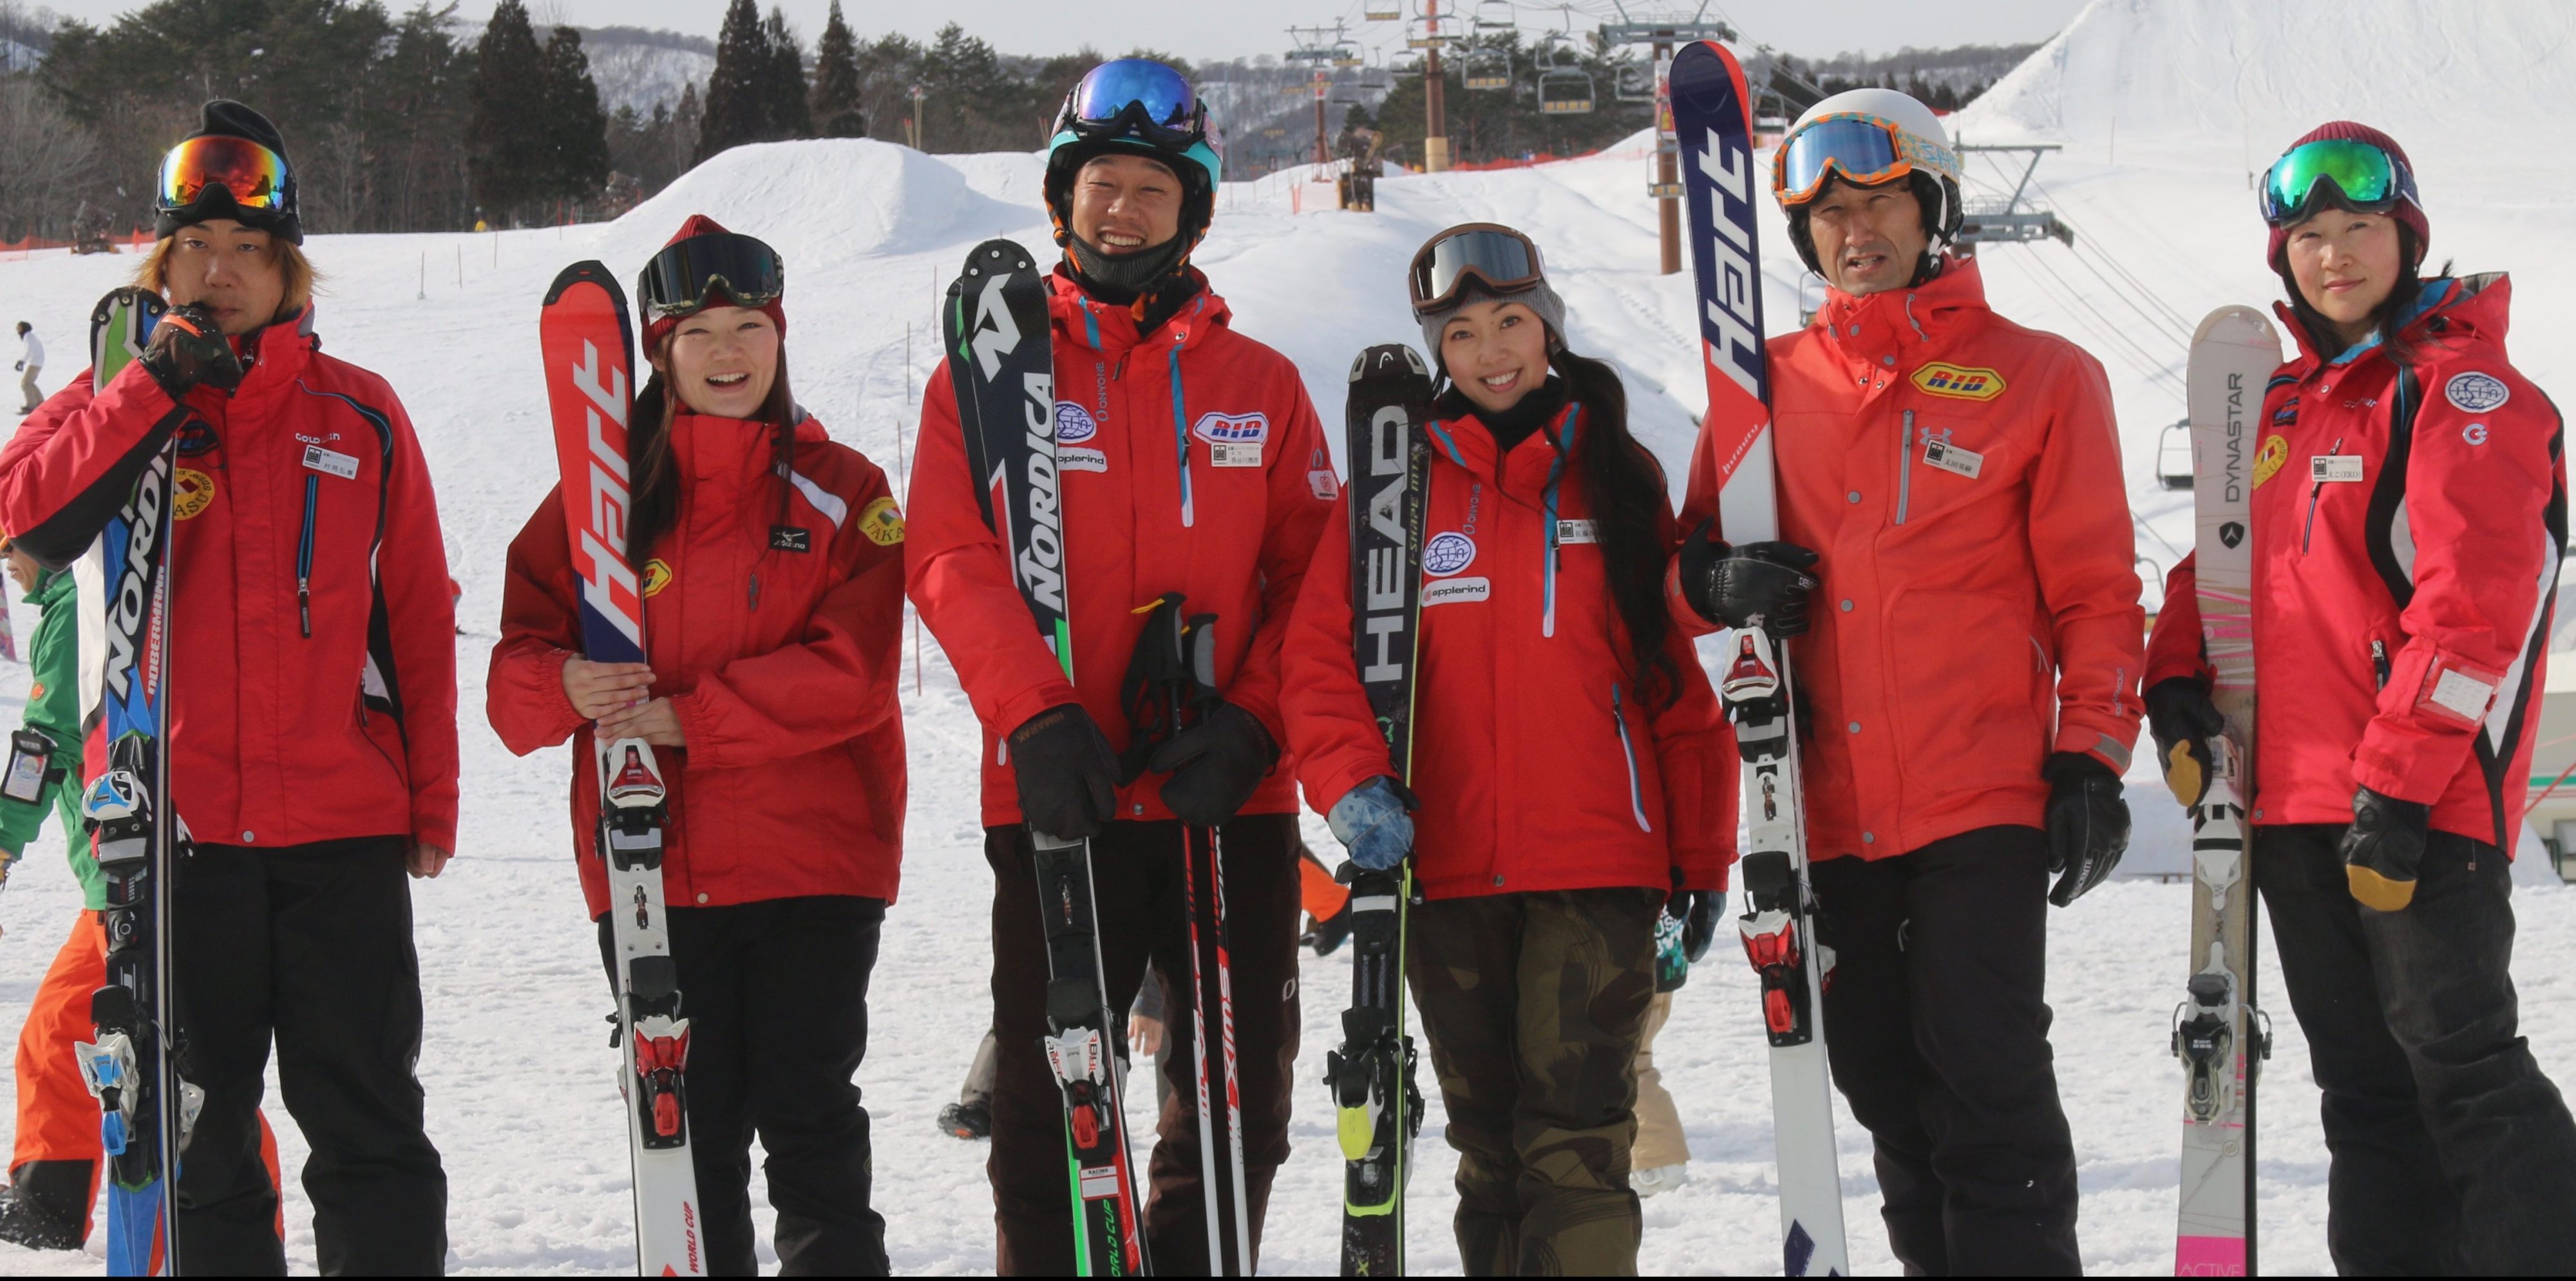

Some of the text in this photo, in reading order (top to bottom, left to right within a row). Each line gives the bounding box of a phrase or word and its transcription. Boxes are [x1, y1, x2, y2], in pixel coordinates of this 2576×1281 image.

[2225, 373, 2243, 502] DYNASTAR
[1019, 372, 1063, 612] NORDICA
[1365, 405, 1408, 683] HEAD
[1432, 585, 1486, 598] applerind
[684, 1200, 699, 1273] WORLD CUP
[1103, 1199, 1116, 1234] CUP
